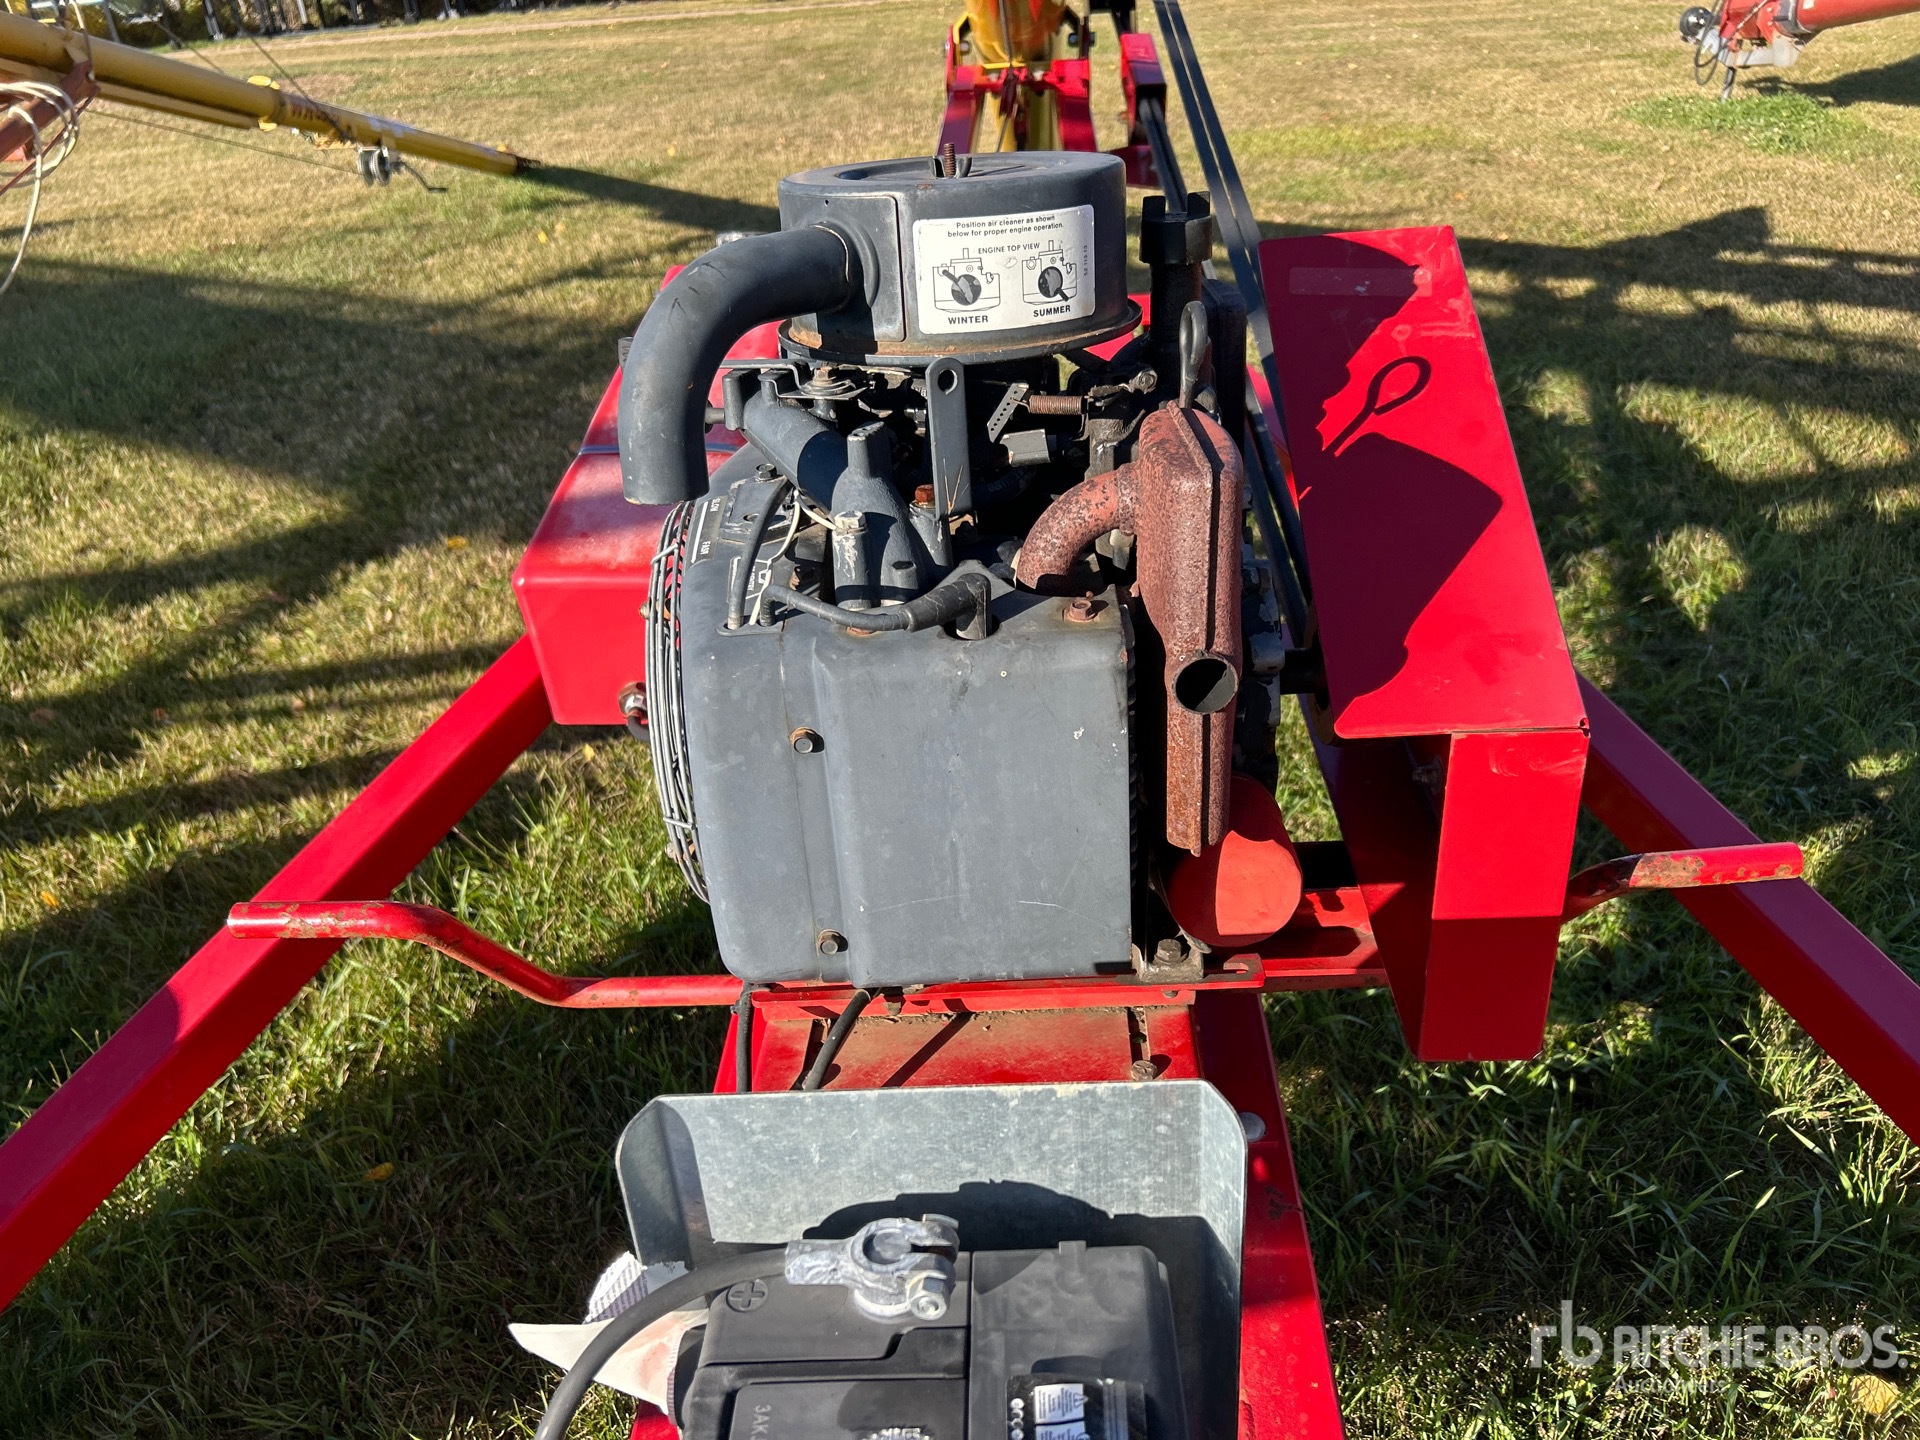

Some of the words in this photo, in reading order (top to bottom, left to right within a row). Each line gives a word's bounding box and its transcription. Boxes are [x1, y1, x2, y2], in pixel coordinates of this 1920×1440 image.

[956, 221, 986, 229] Position
[999, 218, 1025, 226] cleaner
[947, 230, 970, 238] below
[983, 228, 1008, 237] proper
[1009, 225, 1032, 235] engine
[1033, 222, 1064, 232] operation.
[978, 246, 1005, 254] ENGINE
[1007, 244, 1021, 252] TOP
[1022, 242, 1041, 251] VIEW
[1033, 304, 1071, 317] SUMMER
[947, 315, 989, 325] WINTER
